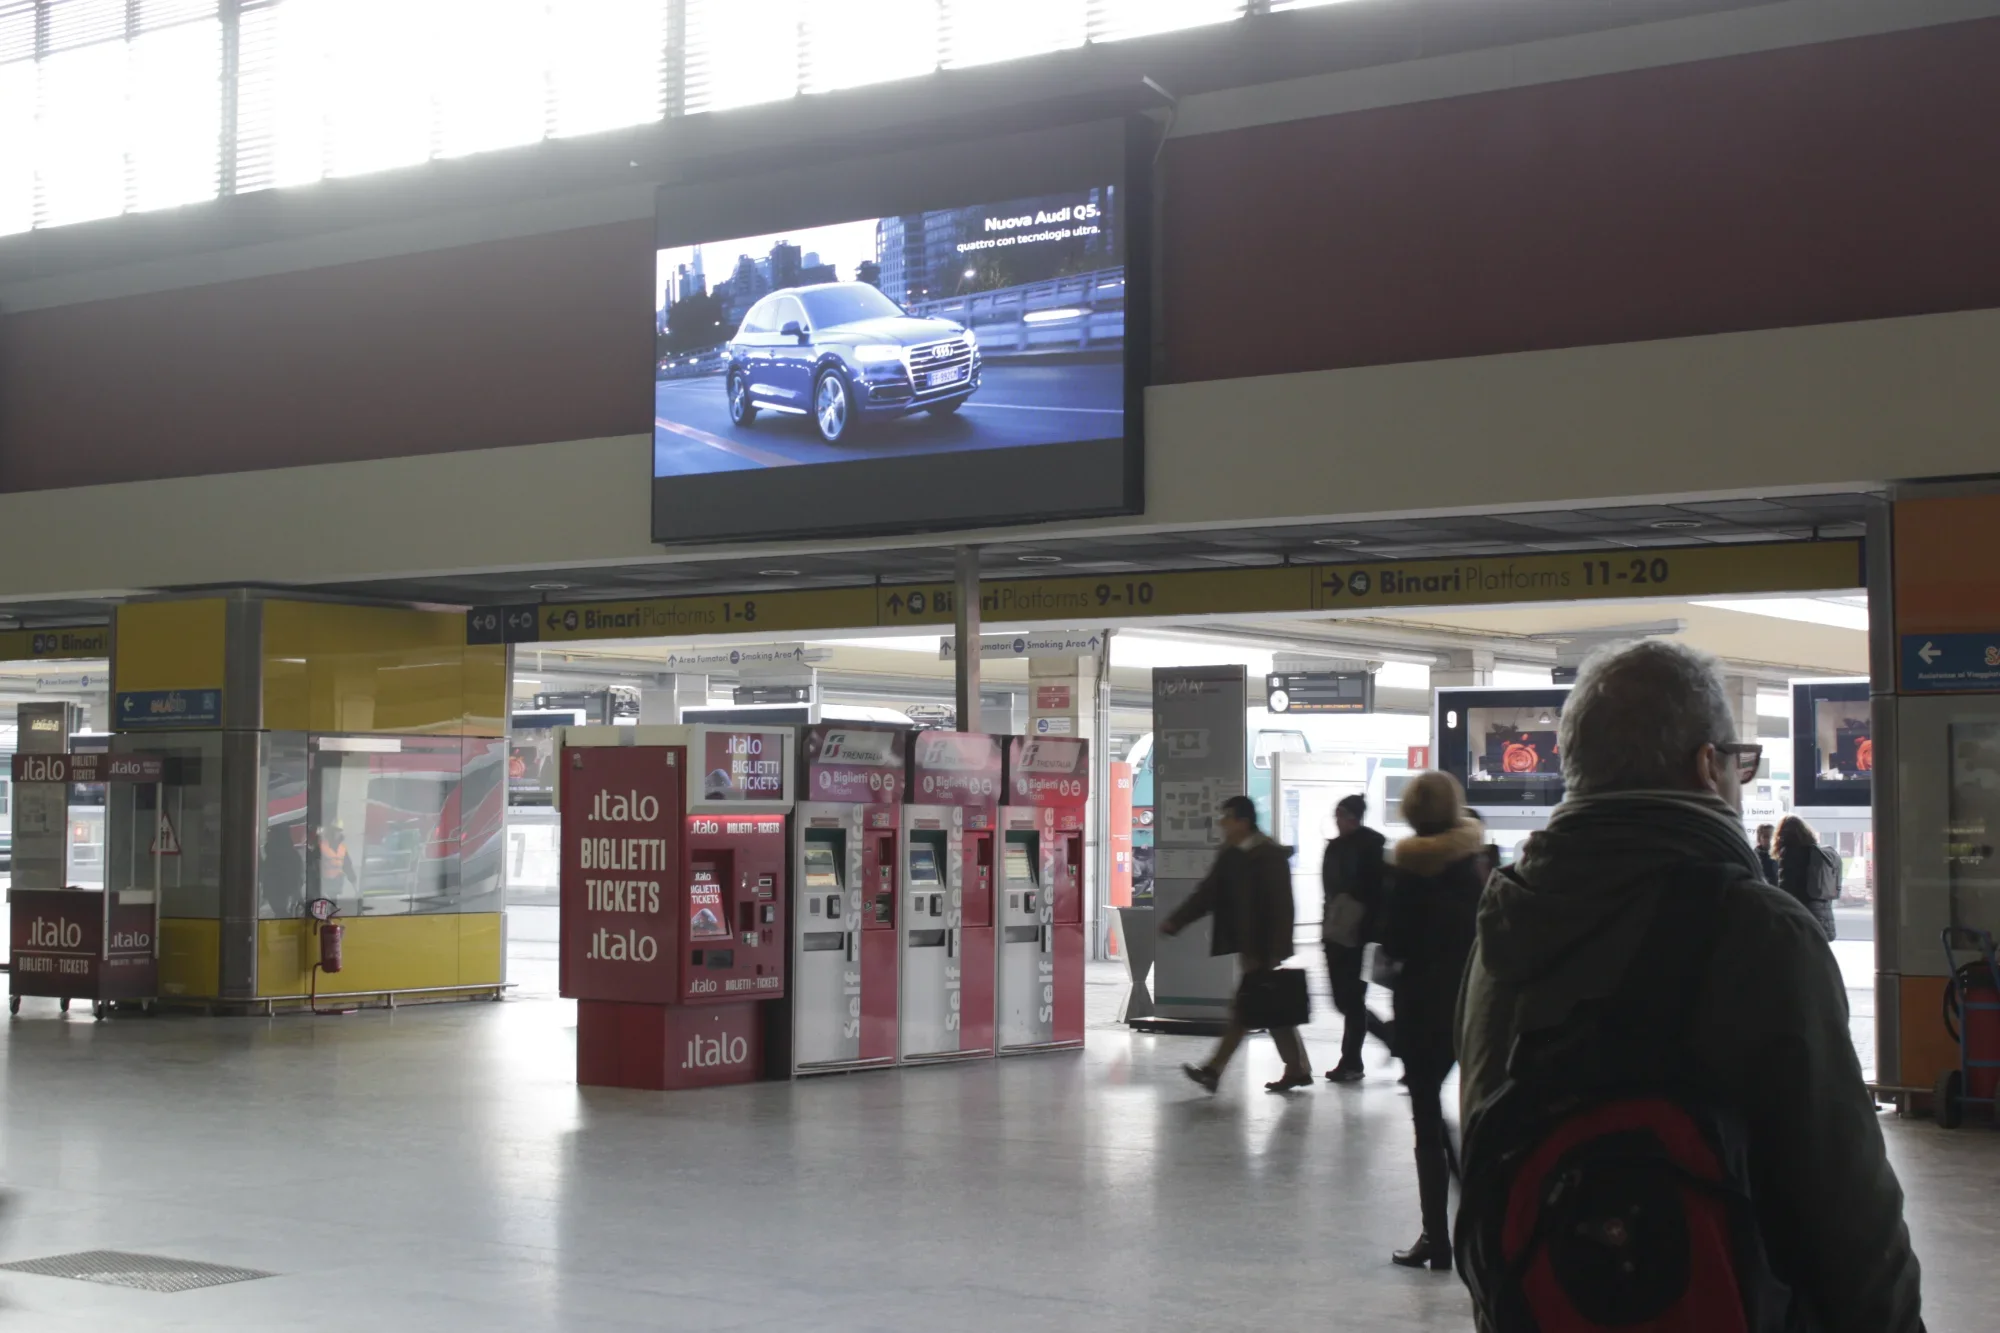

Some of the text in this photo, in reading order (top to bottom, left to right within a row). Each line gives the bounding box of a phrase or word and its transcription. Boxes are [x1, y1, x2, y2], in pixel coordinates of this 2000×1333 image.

[985, 203, 1101, 231] Nuova Audi Q5.
[957, 225, 1100, 252] quattro con tecnologia ultra.
[1380, 558, 1669, 593] Binari Platforms 11-20
[933, 582, 1154, 612] Biri Platforms 9-10
[584, 601, 757, 630] Binari Platforms 1-8
[62, 633, 102, 649] Binari
[1027, 639, 1063, 650] Smoking
[1065, 639, 1086, 648] Area
[679, 650, 792, 664] Area Fumatori Smoking Area
[798, 689, 804, 698] 7
[1447, 710, 1457, 728] 9
[725, 735, 762, 754] .italo
[842, 750, 883, 760] TRENITALIA
[20, 756, 64, 781] .italo
[732, 760, 779, 774] BIGLIETTI
[738, 776, 779, 790] TICKETS
[833, 770, 868, 785] Biglietti
[936, 776, 968, 789] Biglietti
[1029, 778, 1058, 792] Biglietti
[588, 789, 659, 821] .italo
[727, 822, 752, 834] BIGLIETTI
[757, 822, 780, 834] TICKETS
[581, 837, 666, 871] BIGLIETTI
[585, 879, 660, 913] TICKETS
[691, 894, 719, 904] TICKETS
[844, 804, 863, 1039] Self Service
[946, 805, 963, 1031] Self Service
[1039, 807, 1055, 1023] Self Service
[27, 916, 82, 947] .italo
[110, 931, 150, 948] .italo
[586, 927, 657, 962] .italo
[19, 957, 53, 973] BIGLIETTI
[60, 958, 89, 975] TICKETS
[725, 978, 751, 991] BIGLIETTI
[756, 976, 778, 989] TICKETS
[681, 1031, 748, 1069] .italo
